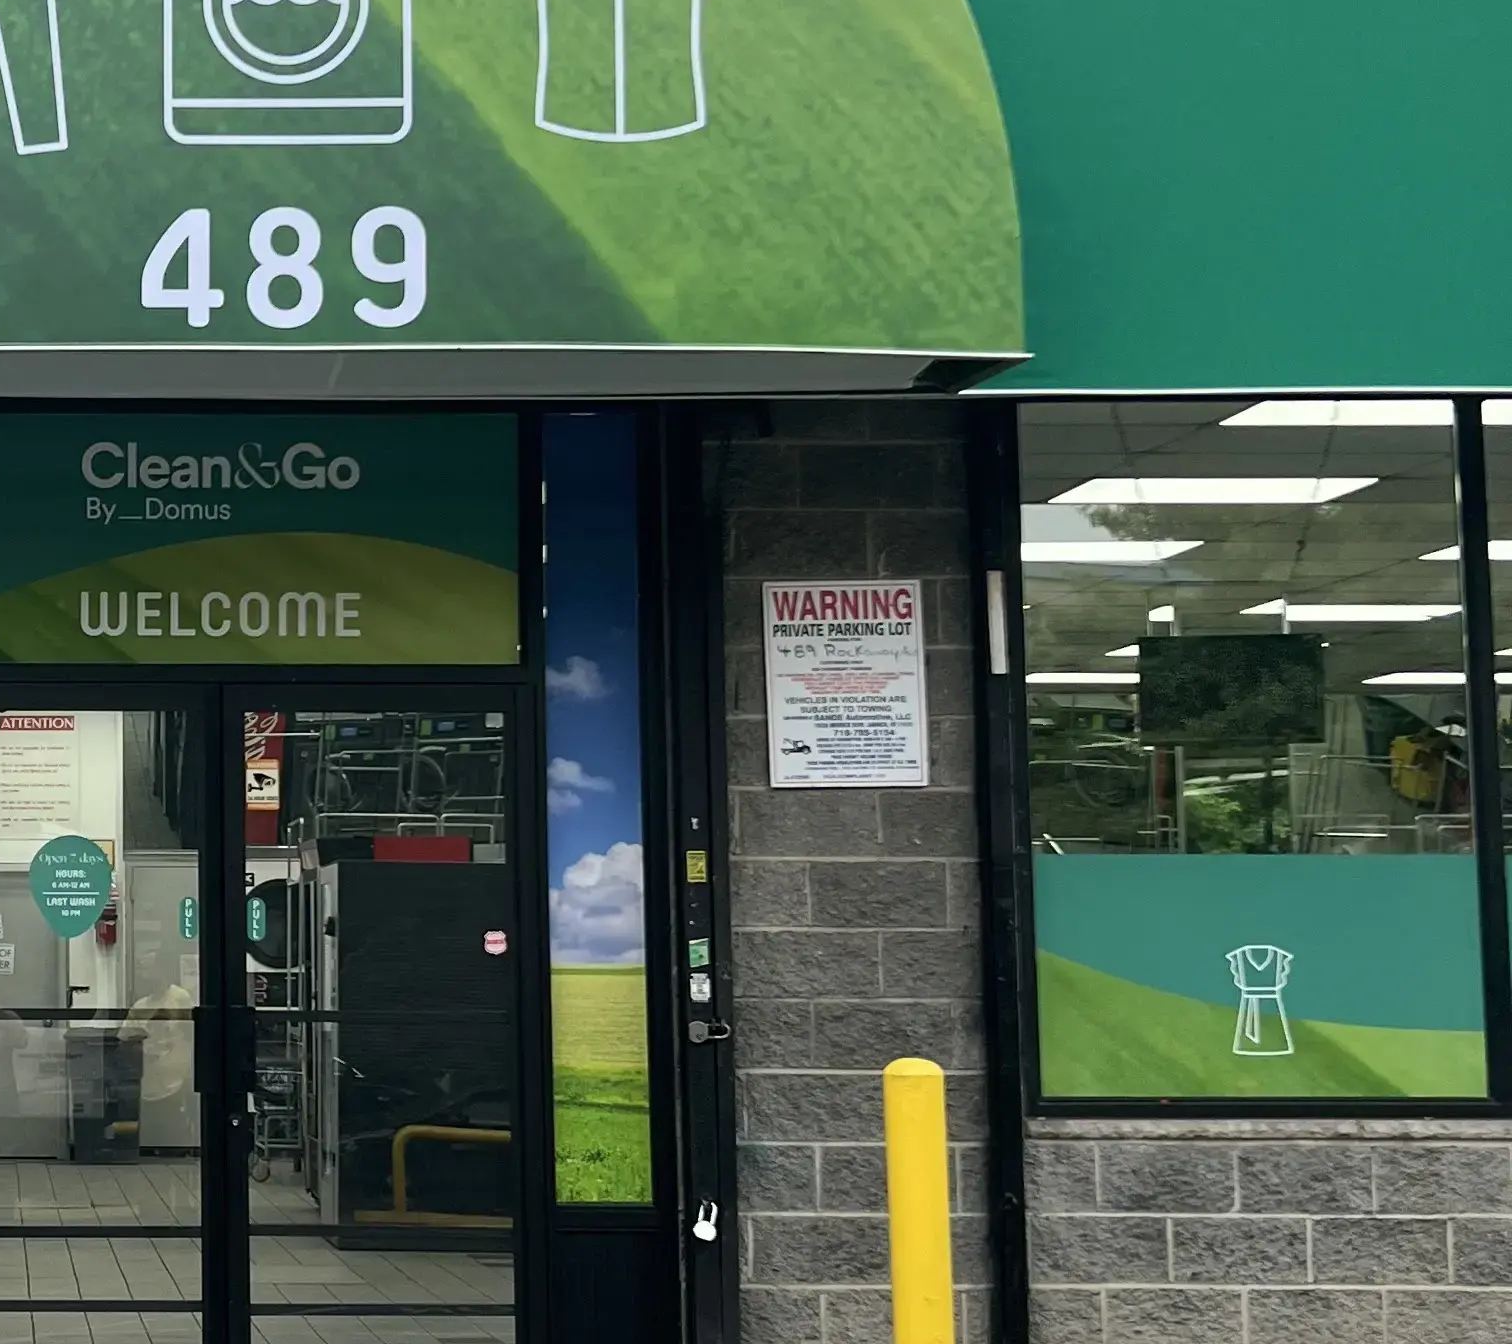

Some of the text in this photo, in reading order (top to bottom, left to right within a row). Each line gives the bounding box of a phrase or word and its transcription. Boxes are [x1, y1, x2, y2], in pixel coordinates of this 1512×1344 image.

[141, 206, 429, 328] 489
[772, 588, 913, 621] WARNING
[80, 591, 362, 637] WELCOME
[772, 622, 912, 637] PRIVATE PARKING LOT
[777, 644, 816, 659] 489
[784, 696, 828, 704] VEHICLES
[839, 695, 887, 704] VIOLATION
[887, 695, 907, 703] ARE
[800, 706, 841, 714] SUBJECT
[857, 705, 893, 713] TOWING
[0, 717, 74, 729] ATTENTION
[39, 853, 68, 865] Open
[79, 852, 104, 865] days
[55, 869, 86, 878] HOURS:
[46, 898, 95, 906] LAST WASH
[252, 900, 260, 939] PULL
